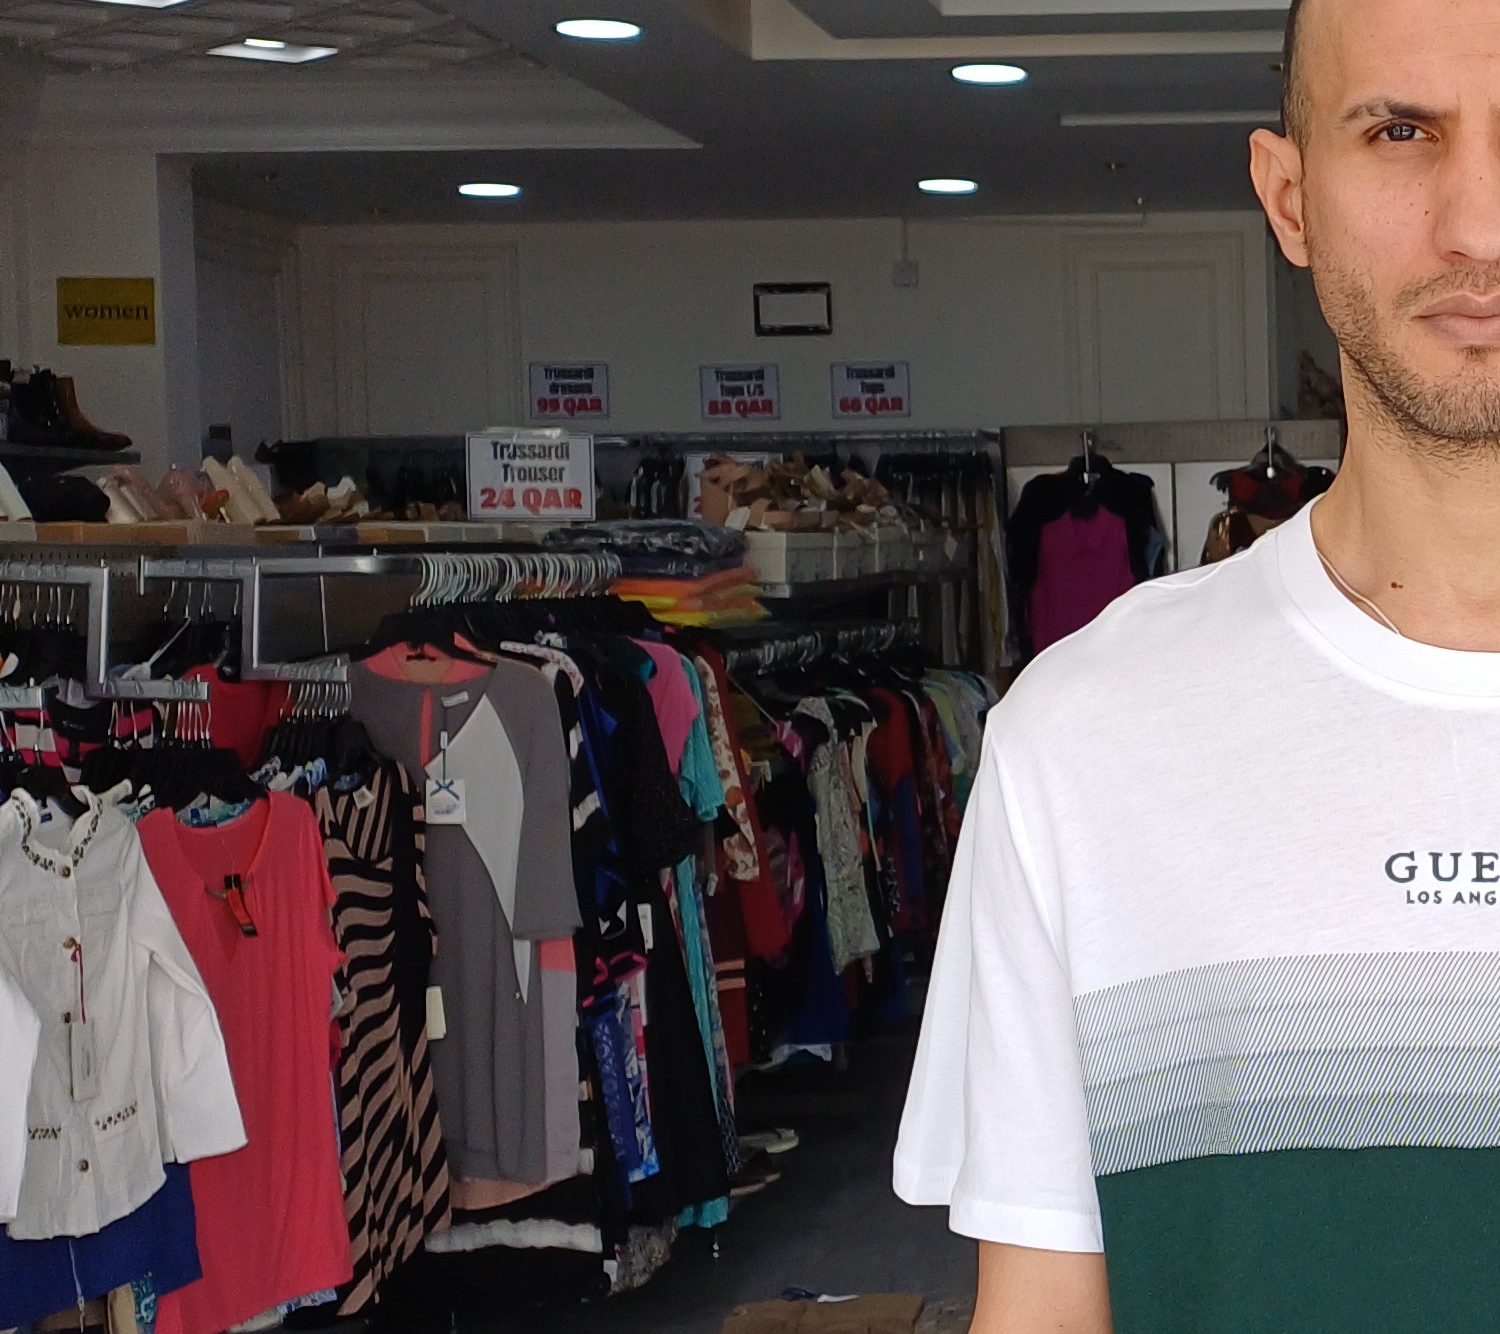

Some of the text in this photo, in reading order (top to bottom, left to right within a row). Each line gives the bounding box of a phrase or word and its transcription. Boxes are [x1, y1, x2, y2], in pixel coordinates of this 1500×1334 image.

[64, 303, 148, 321] women
[562, 397, 602, 417] QAR
[735, 399, 774, 418] QAR
[865, 397, 904, 416] QAR
[491, 441, 570, 460] Trussardi
[502, 464, 566, 483] Trouser
[480, 488, 583, 514] 24 QAR
[1406, 890, 1443, 904] LOS
